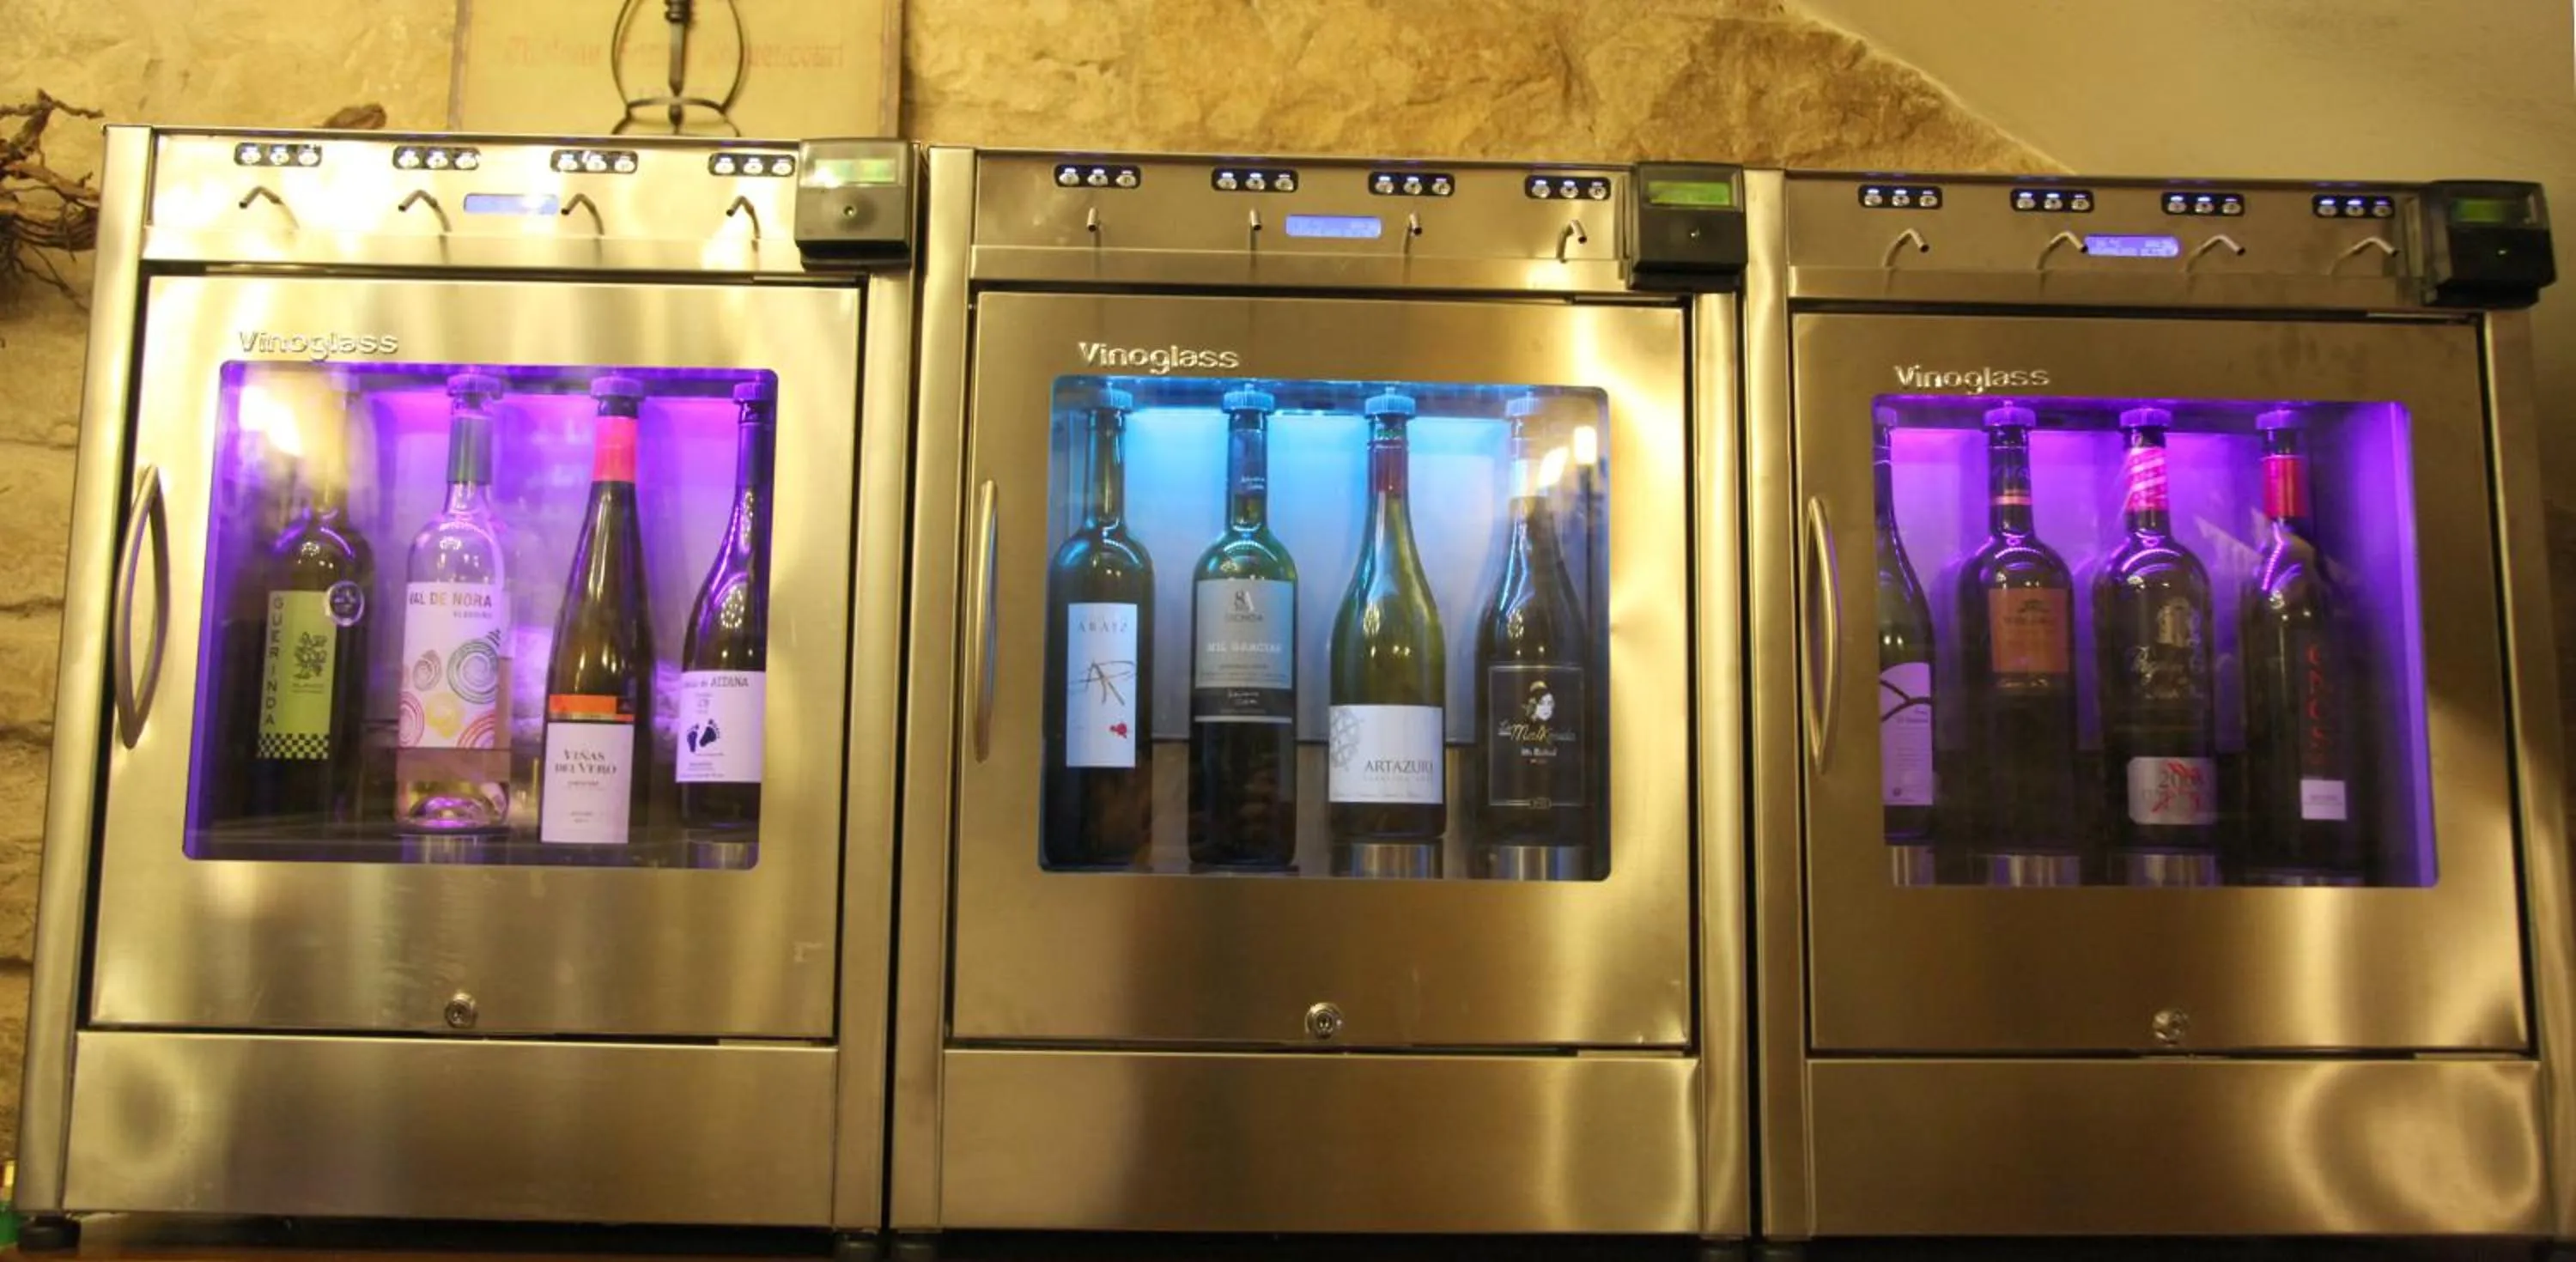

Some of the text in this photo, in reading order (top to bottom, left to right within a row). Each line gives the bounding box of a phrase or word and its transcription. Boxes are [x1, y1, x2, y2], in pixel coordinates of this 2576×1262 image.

[240, 331, 399, 361] Vinoglass
[1078, 342, 1240, 374] Vinoglass
[1893, 364, 2050, 395] Vinoglass
[429, 592, 447, 606] DE
[453, 592, 492, 608] NORA
[264, 597, 285, 726] GUERINDA
[1364, 760, 1434, 774] ARTAZURI
